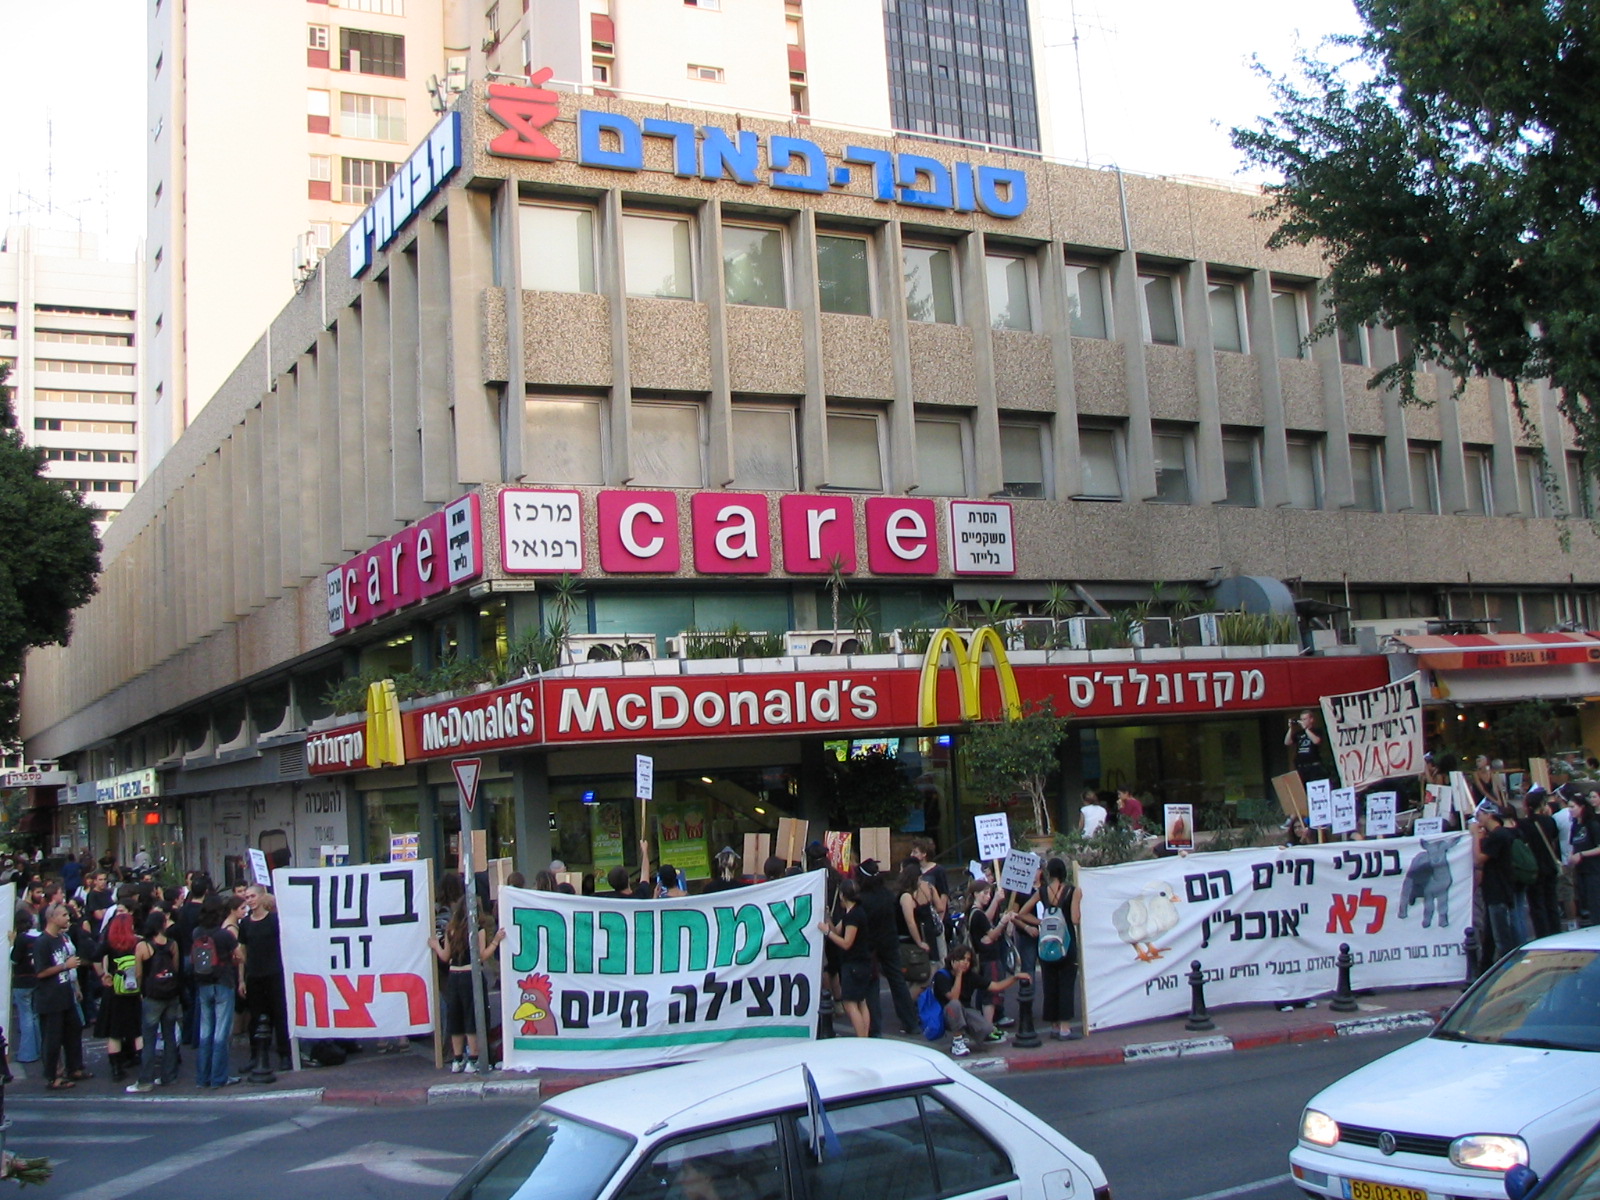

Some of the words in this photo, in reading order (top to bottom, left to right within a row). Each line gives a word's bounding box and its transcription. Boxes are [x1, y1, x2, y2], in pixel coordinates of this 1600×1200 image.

[513, 503, 573, 522] מרכז
[968, 511, 997, 523] הסרת
[619, 502, 927, 561] care
[961, 531, 1006, 547] משקפיים
[511, 539, 578, 558] רפואי
[970, 550, 1000, 564] בלייזר
[345, 529, 433, 615] care
[1510, 652, 1535, 663] BAGEL
[1541, 651, 1557, 662] BAR
[1068, 668, 1266, 708] מקדונלד'ס
[558, 680, 878, 734] McDonald's
[423, 692, 534, 751] McDonald's
[1371, 715, 1416, 741] רגישים
[1336, 722, 1366, 747] לסבל
[305, 788, 341, 813] להשכרה
[1312, 785, 1326, 793] די
[1336, 792, 1351, 800] די
[1373, 796, 1391, 804] די
[984, 842, 1007, 855] חיים
[1010, 853, 1035, 866] זכויות
[1009, 864, 1031, 877] לבעלי
[1251, 858, 1315, 891] חיים
[1334, 848, 1403, 881] בעלי
[1005, 878, 1027, 889] החיים
[1184, 869, 1233, 904] הם
[288, 870, 419, 929] בשר
[1326, 887, 1388, 934] לא
[512, 893, 813, 975] צמחונות
[330, 935, 373, 969] זה
[1368, 947, 1401, 962] פוגעת
[1404, 945, 1428, 958] בשר
[1229, 963, 1259, 978] החיים
[1265, 960, 1301, 974] בבעלי
[1145, 974, 1178, 996] הארץ
[293, 972, 430, 1028] רצח
[561, 989, 649, 1029] חיים
[668, 971, 811, 1025] מצילה
